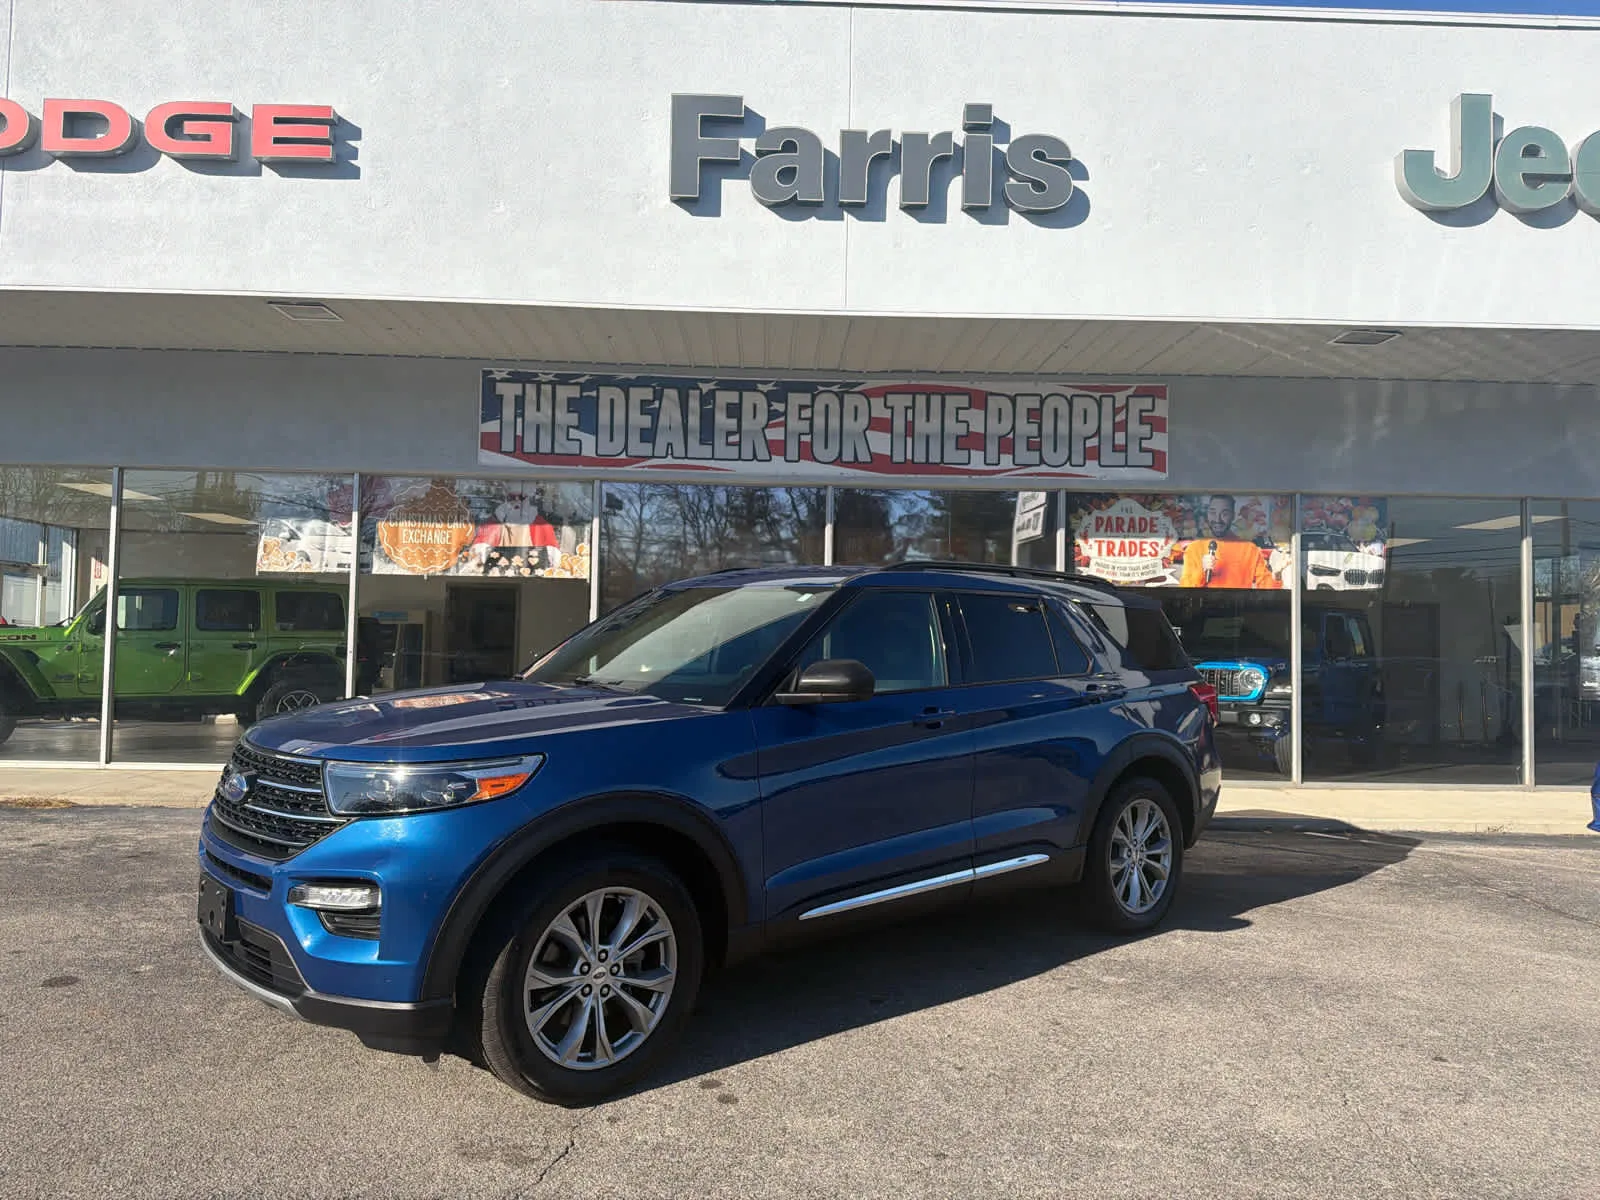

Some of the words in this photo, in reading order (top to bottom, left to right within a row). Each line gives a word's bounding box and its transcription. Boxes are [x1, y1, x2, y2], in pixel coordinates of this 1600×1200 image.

[670, 93, 1074, 212] Farris
[495, 382, 582, 454] THE
[595, 384, 772, 462] DEALER
[784, 389, 873, 465] FOR
[884, 392, 972, 466] THE
[984, 393, 1156, 468] PEOPLE
[389, 511, 444, 528] CHRISTMAS
[447, 512, 467, 529] CAR
[1095, 516, 1159, 533] PARADE
[402, 529, 453, 545] EXCHANGE
[1095, 540, 1160, 558] TRADES
